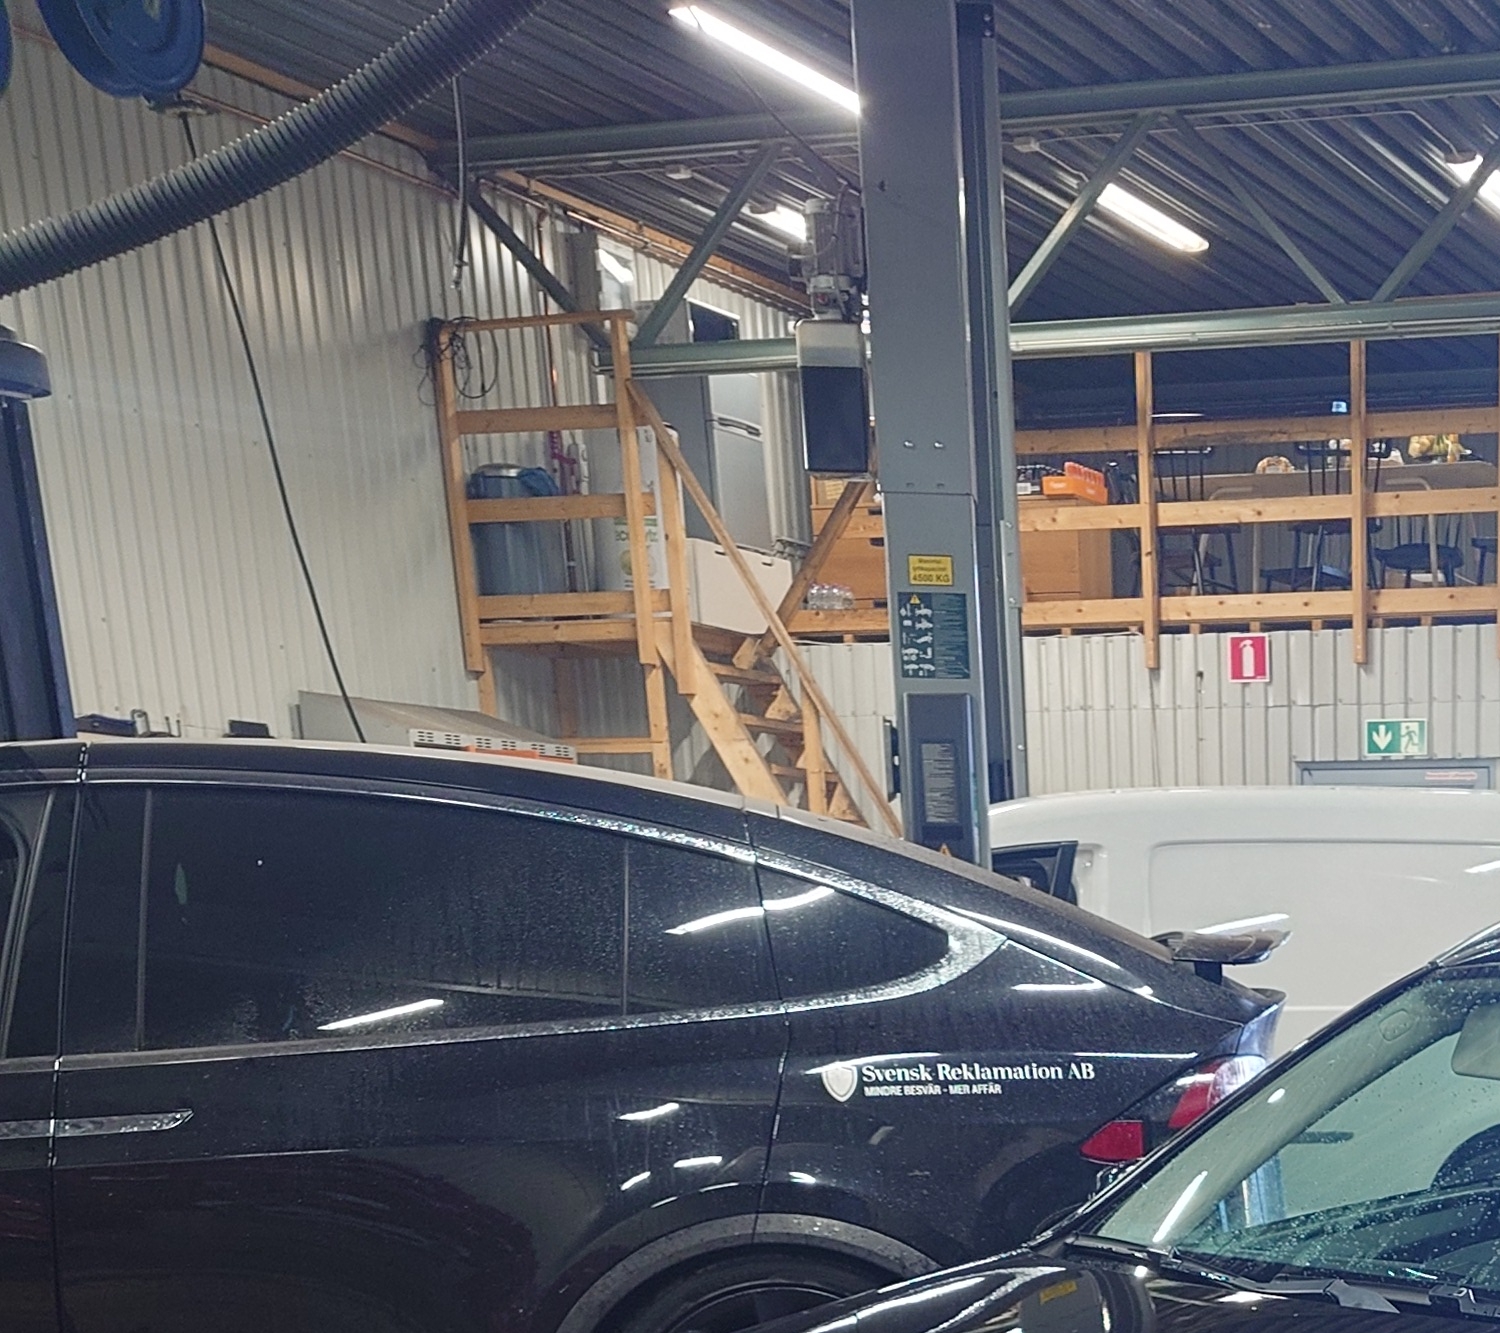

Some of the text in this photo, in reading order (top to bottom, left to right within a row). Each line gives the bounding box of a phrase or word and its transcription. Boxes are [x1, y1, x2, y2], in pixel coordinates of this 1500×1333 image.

[861, 1062, 1096, 1082] Svensk Reklamation AB
